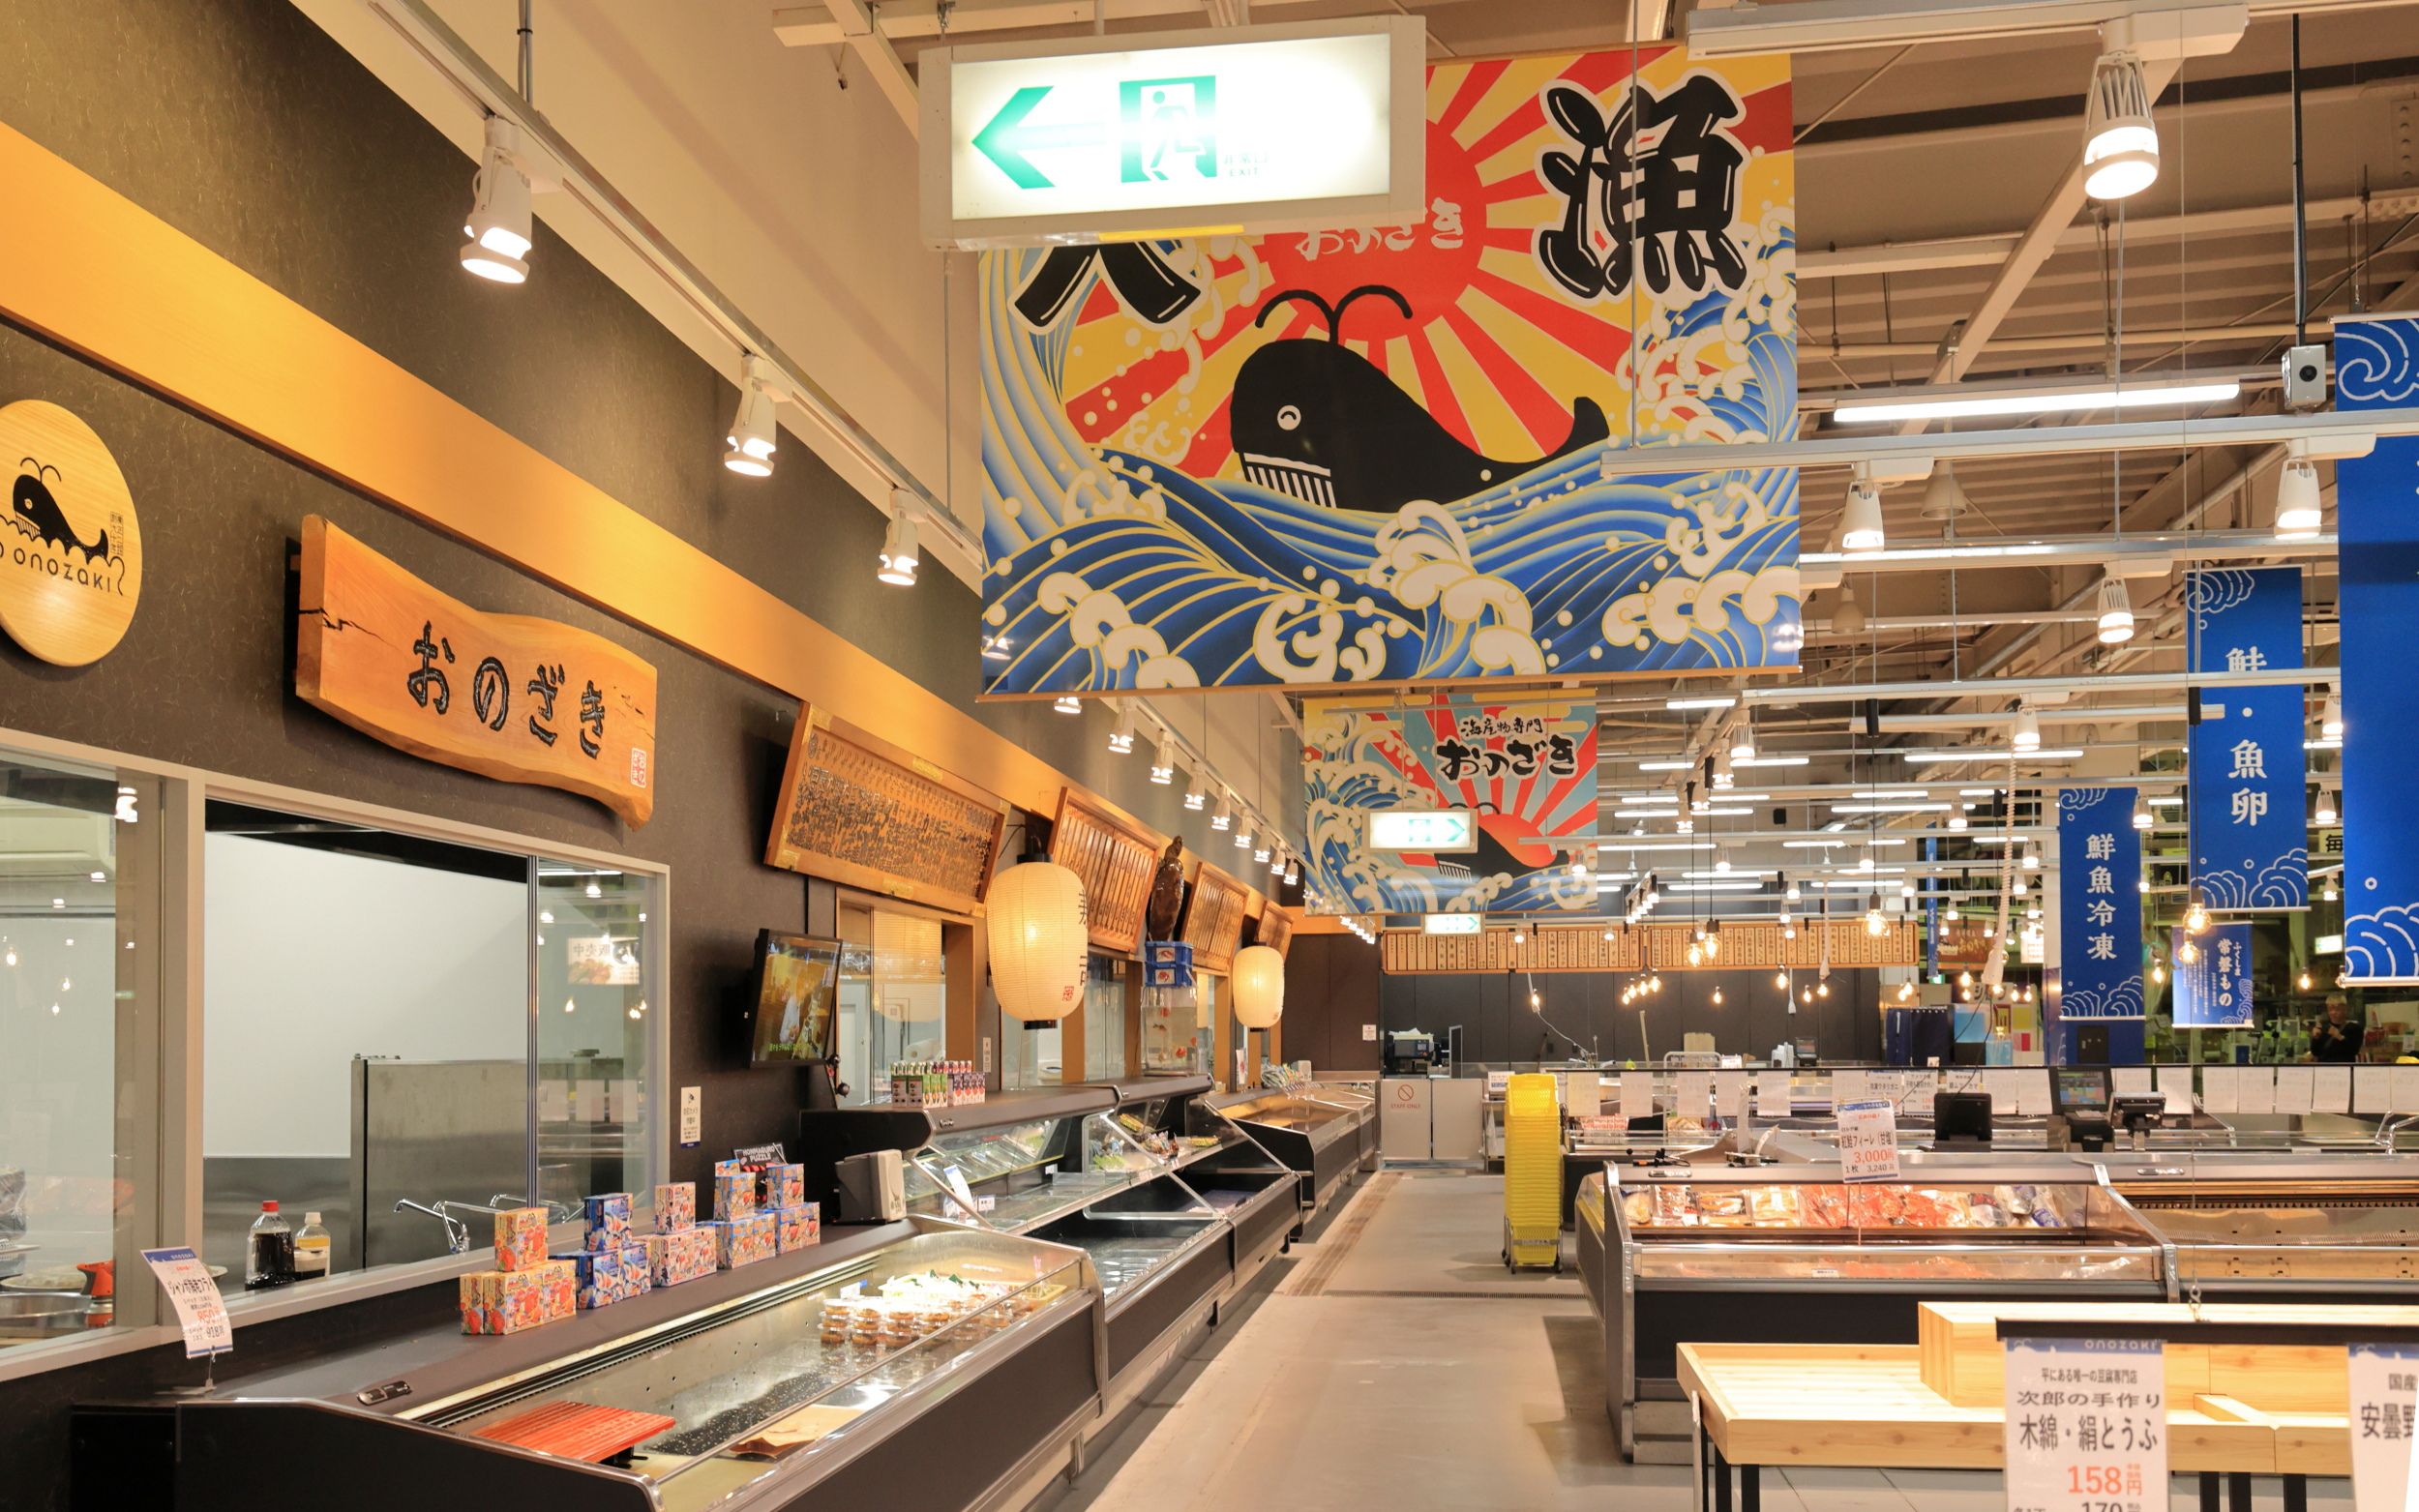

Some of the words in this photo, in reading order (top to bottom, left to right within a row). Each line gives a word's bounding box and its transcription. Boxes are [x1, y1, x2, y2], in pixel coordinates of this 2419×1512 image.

[1537, 75, 1747, 300] 漁
[14, 547, 111, 594] onozaki
[407, 620, 606, 760] おのざき
[1461, 716, 1543, 737] 海産物専門
[1436, 734, 1575, 781] おのざき
[2085, 833, 2118, 961] 鮮魚冷凍
[1853, 1149, 1888, 1165] 3,000
[1867, 1164, 1888, 1173] 3,240
[2083, 1338, 2158, 1350] onozaki
[2017, 1390, 2160, 1409] 次郎の手作り
[2019, 1412, 2158, 1452] 木綿・絹とうふ
[2067, 1464, 2123, 1496] 158
